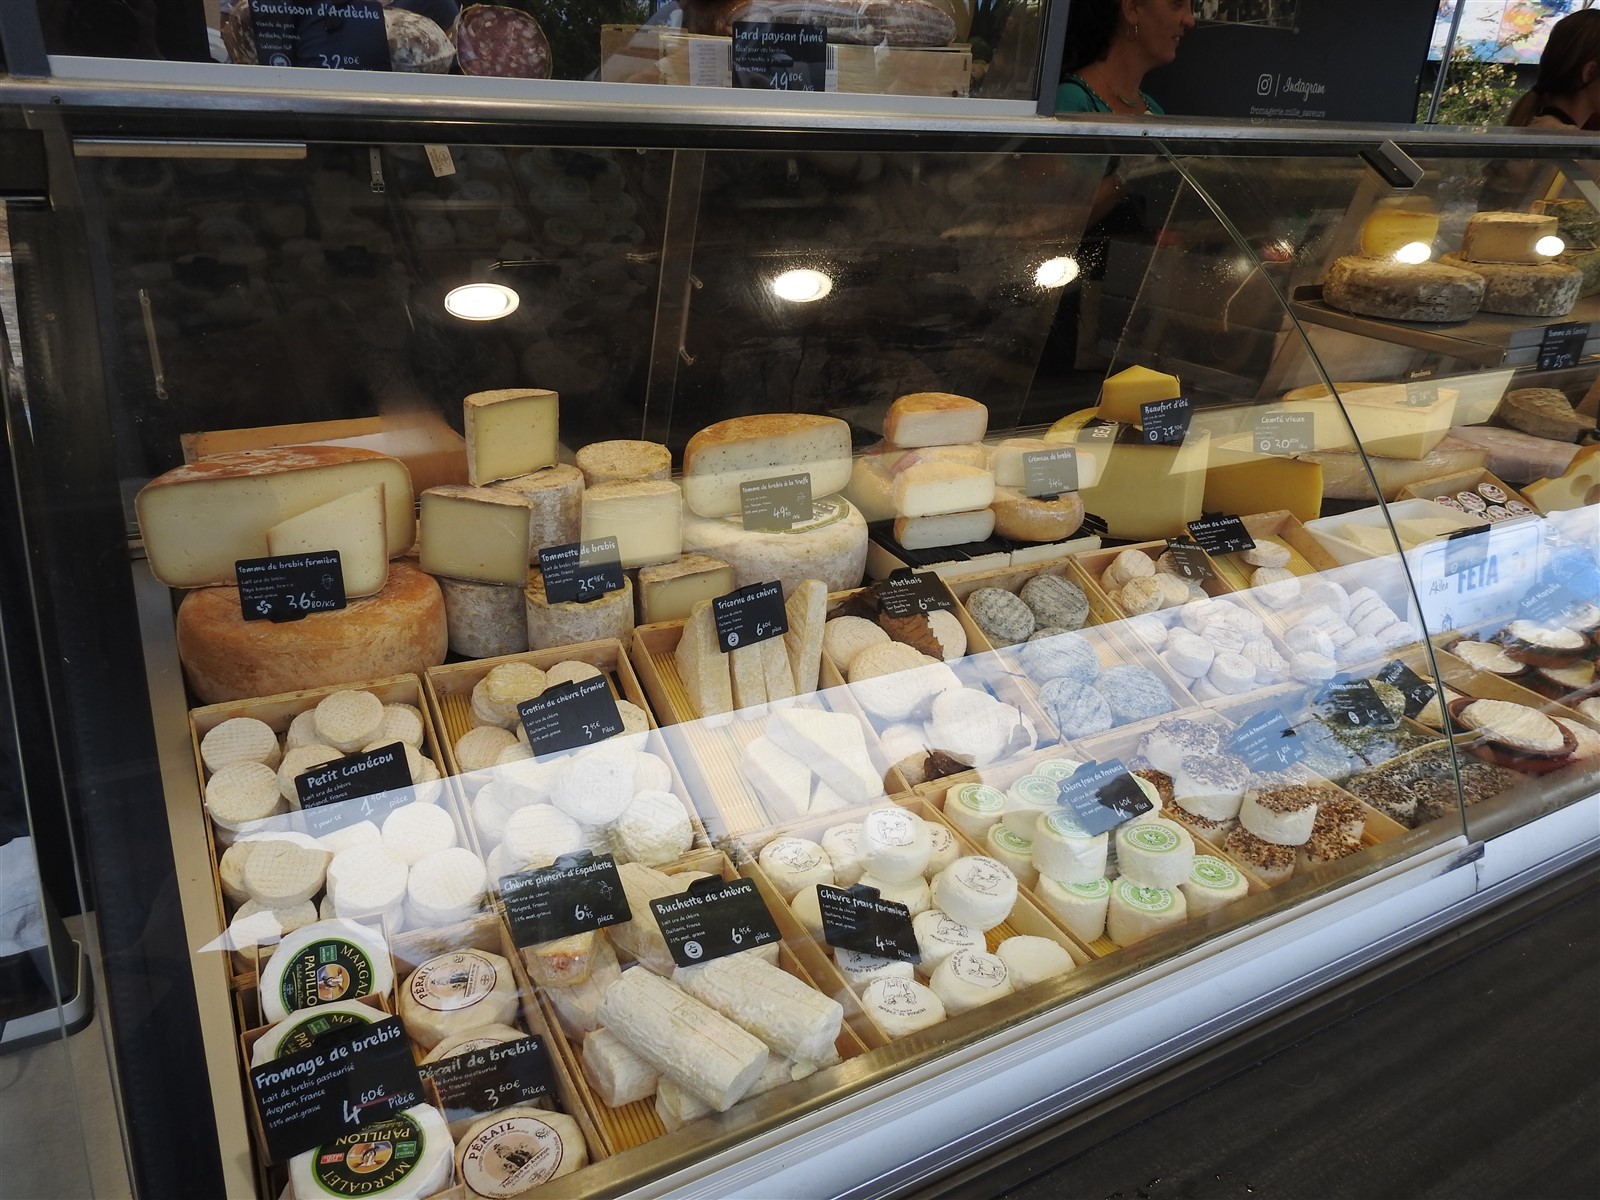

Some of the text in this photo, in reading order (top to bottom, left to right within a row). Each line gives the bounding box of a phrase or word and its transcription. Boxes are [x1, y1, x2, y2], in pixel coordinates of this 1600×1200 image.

[252, 2, 380, 19] Saucisson d'Ardèche
[735, 27, 824, 45] Lard paysan fumé
[343, 56, 360, 65] 80€
[769, 72, 788, 90] 19
[788, 72, 804, 82] 80€
[1283, 77, 1326, 101] Instagram
[1144, 402, 1172, 414] Beaufort
[1261, 415, 1284, 424] Comté
[768, 481, 783, 489] brebis
[541, 541, 616, 562] Tommette de brebis
[279, 561, 304, 569] brebis
[1457, 554, 1499, 593] FETA
[890, 576, 922, 588] Mothais
[746, 594, 755, 602] de
[919, 599, 928, 610] 6
[756, 623, 763, 636] 6
[522, 681, 606, 716] Crottin de chèvre fermier
[582, 725, 593, 739] 3
[307, 770, 338, 789] Petit
[361, 797, 375, 817] 1
[1112, 803, 1127, 819] 4
[504, 860, 613, 892] Chèvre piment d'Espellette
[656, 884, 752, 915] Buchette de chèvre
[820, 889, 907, 917] Chèvre frais fermier
[574, 904, 585, 921] 6
[731, 928, 743, 945] 6
[875, 935, 885, 951] 4
[304, 955, 318, 1007] PAPILLO
[340, 945, 369, 999] MARGAL
[413, 966, 435, 1000] PÉRAIL
[255, 1024, 401, 1090] Fromage de brebis
[418, 1040, 538, 1080] Pérail de brebis
[262, 1062, 356, 1105] Lait de brebis pasteurisé
[522, 1085, 546, 1096] Pièce
[300, 1088, 326, 1103] France
[388, 1091, 416, 1109] Pièce
[484, 1080, 520, 1107] 3 60€
[342, 1084, 385, 1125] 4 60€
[336, 1128, 410, 1146] PAPILLON
[469, 1123, 515, 1160] PÉRAIL
[322, 1161, 412, 1193] MARGALET
